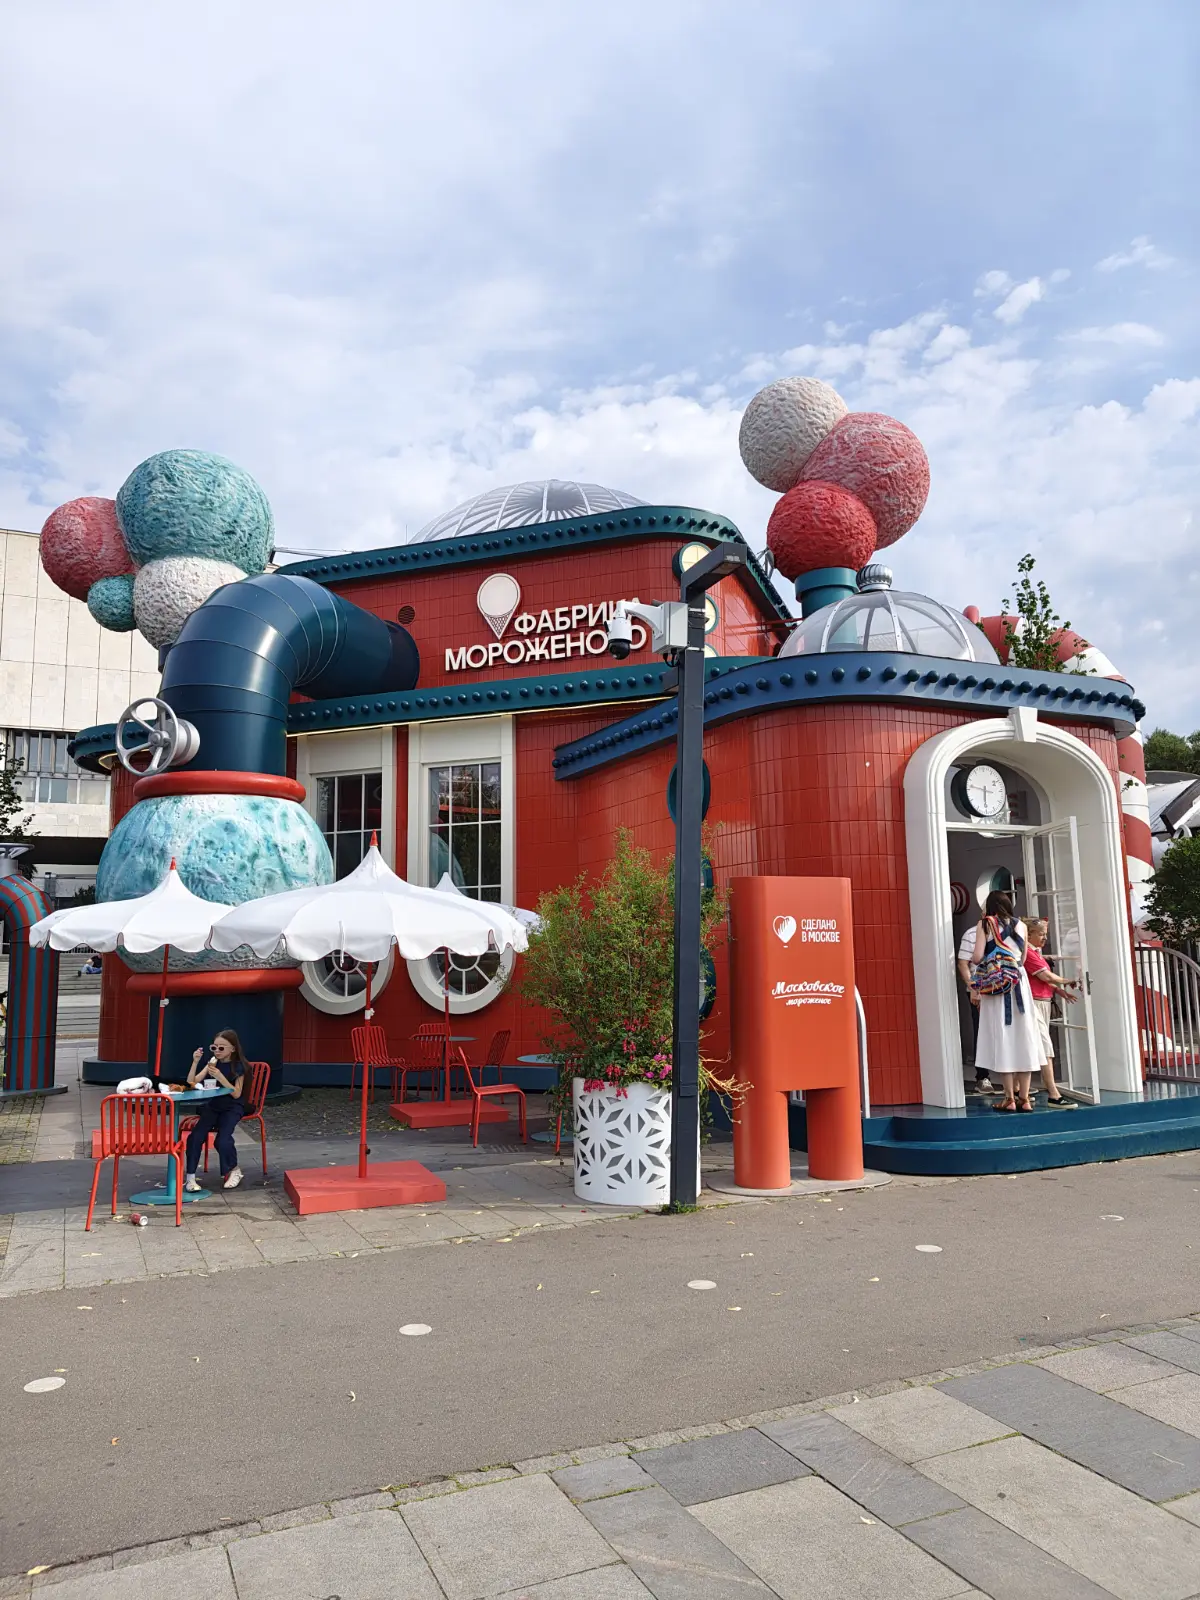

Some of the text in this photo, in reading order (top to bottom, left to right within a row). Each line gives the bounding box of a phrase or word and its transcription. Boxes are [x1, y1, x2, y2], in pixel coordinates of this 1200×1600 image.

[445, 625, 646, 670] МОРОЖЕНОО
[801, 919, 836, 930] СДЕЛАНО
[802, 931, 840, 942] В МОСКВЕ
[771, 981, 844, 995] Московское
